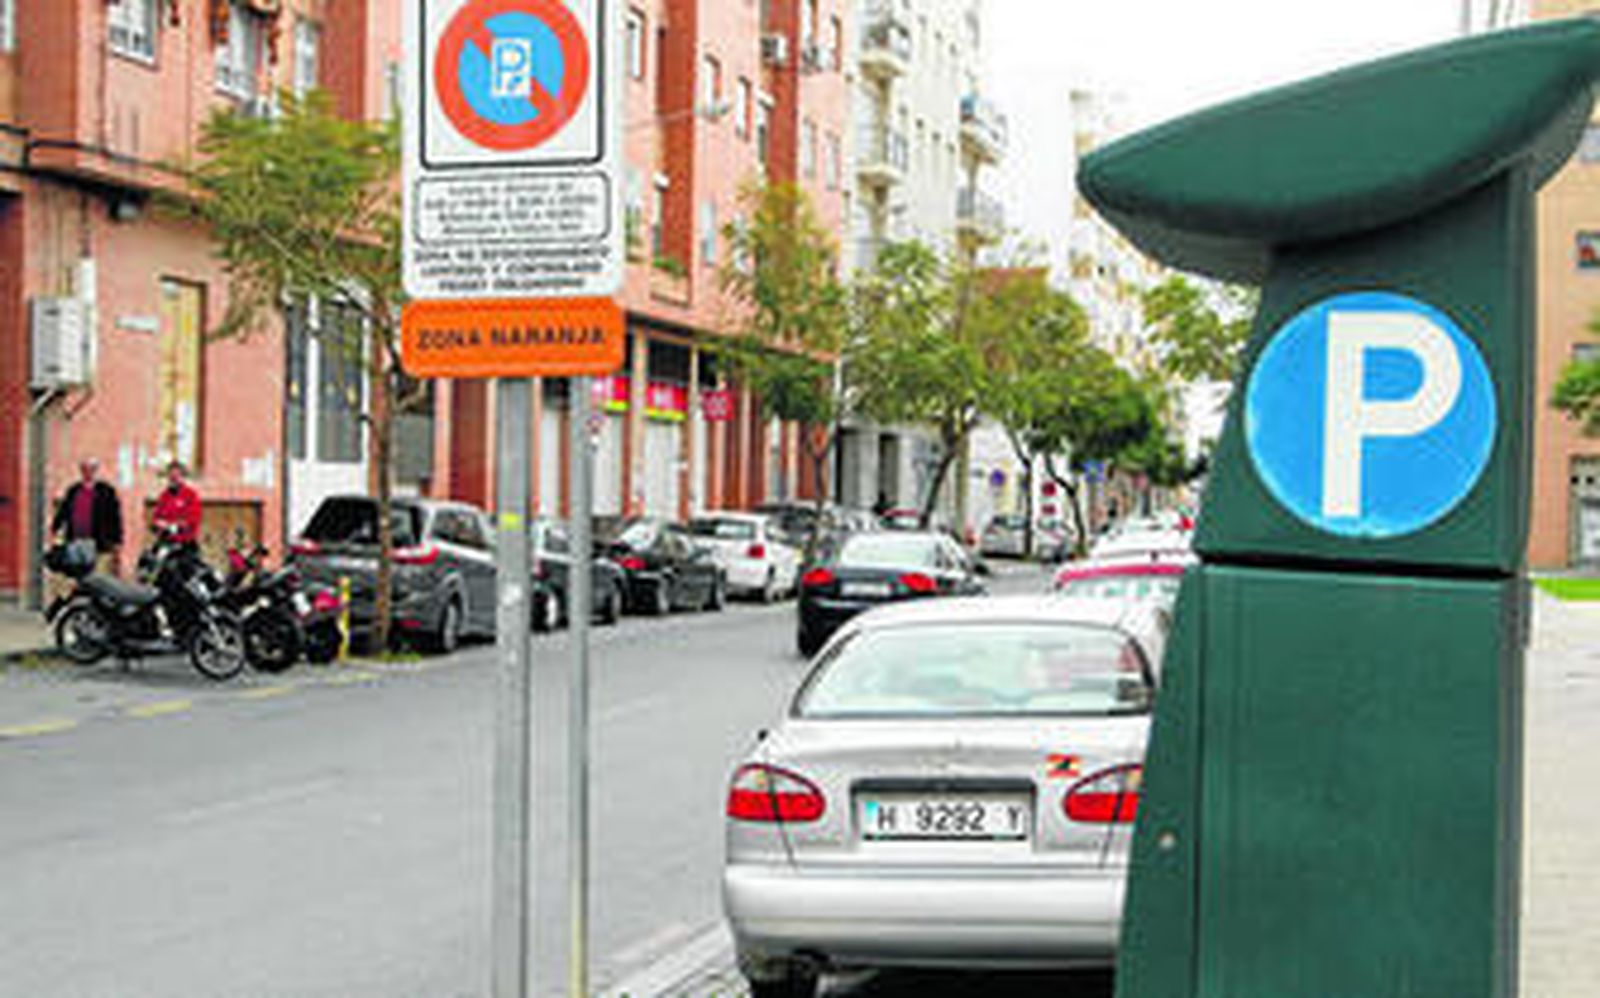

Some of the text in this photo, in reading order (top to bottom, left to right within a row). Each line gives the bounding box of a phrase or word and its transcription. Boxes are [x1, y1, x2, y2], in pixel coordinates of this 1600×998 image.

[417, 325, 604, 350] ZONA NARANJA
[1321, 311, 1463, 518] P
[877, 805, 896, 830] H
[1007, 804, 1023, 830] Y
